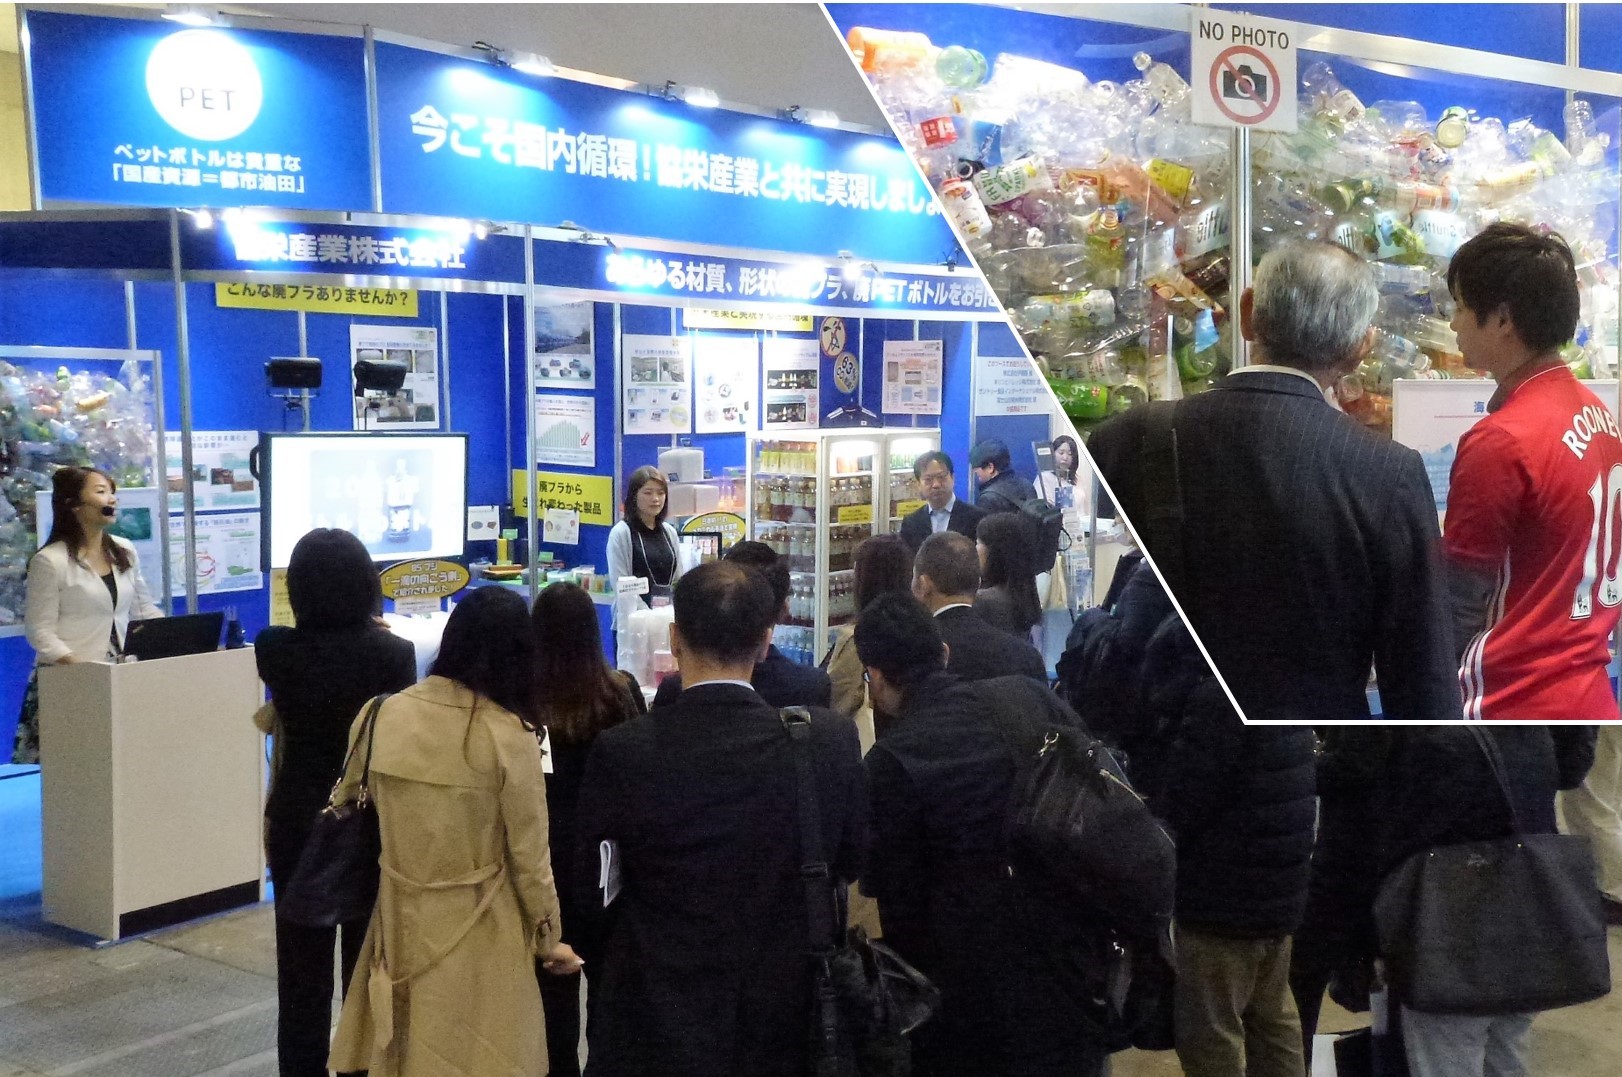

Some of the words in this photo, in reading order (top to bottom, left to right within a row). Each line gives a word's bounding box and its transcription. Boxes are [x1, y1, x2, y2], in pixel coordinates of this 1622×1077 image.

[1199, 20, 1224, 41] NO
[1231, 25, 1290, 49] PHOTO
[179, 86, 236, 111] PET
[114, 143, 302, 172] ペットボトルは貴重な
[235, 231, 466, 268] 栄産業株式会社
[539, 480, 583, 496] 廃プラから
[522, 496, 602, 515] 生れ変わった製品
[1569, 462, 1622, 620] 10
